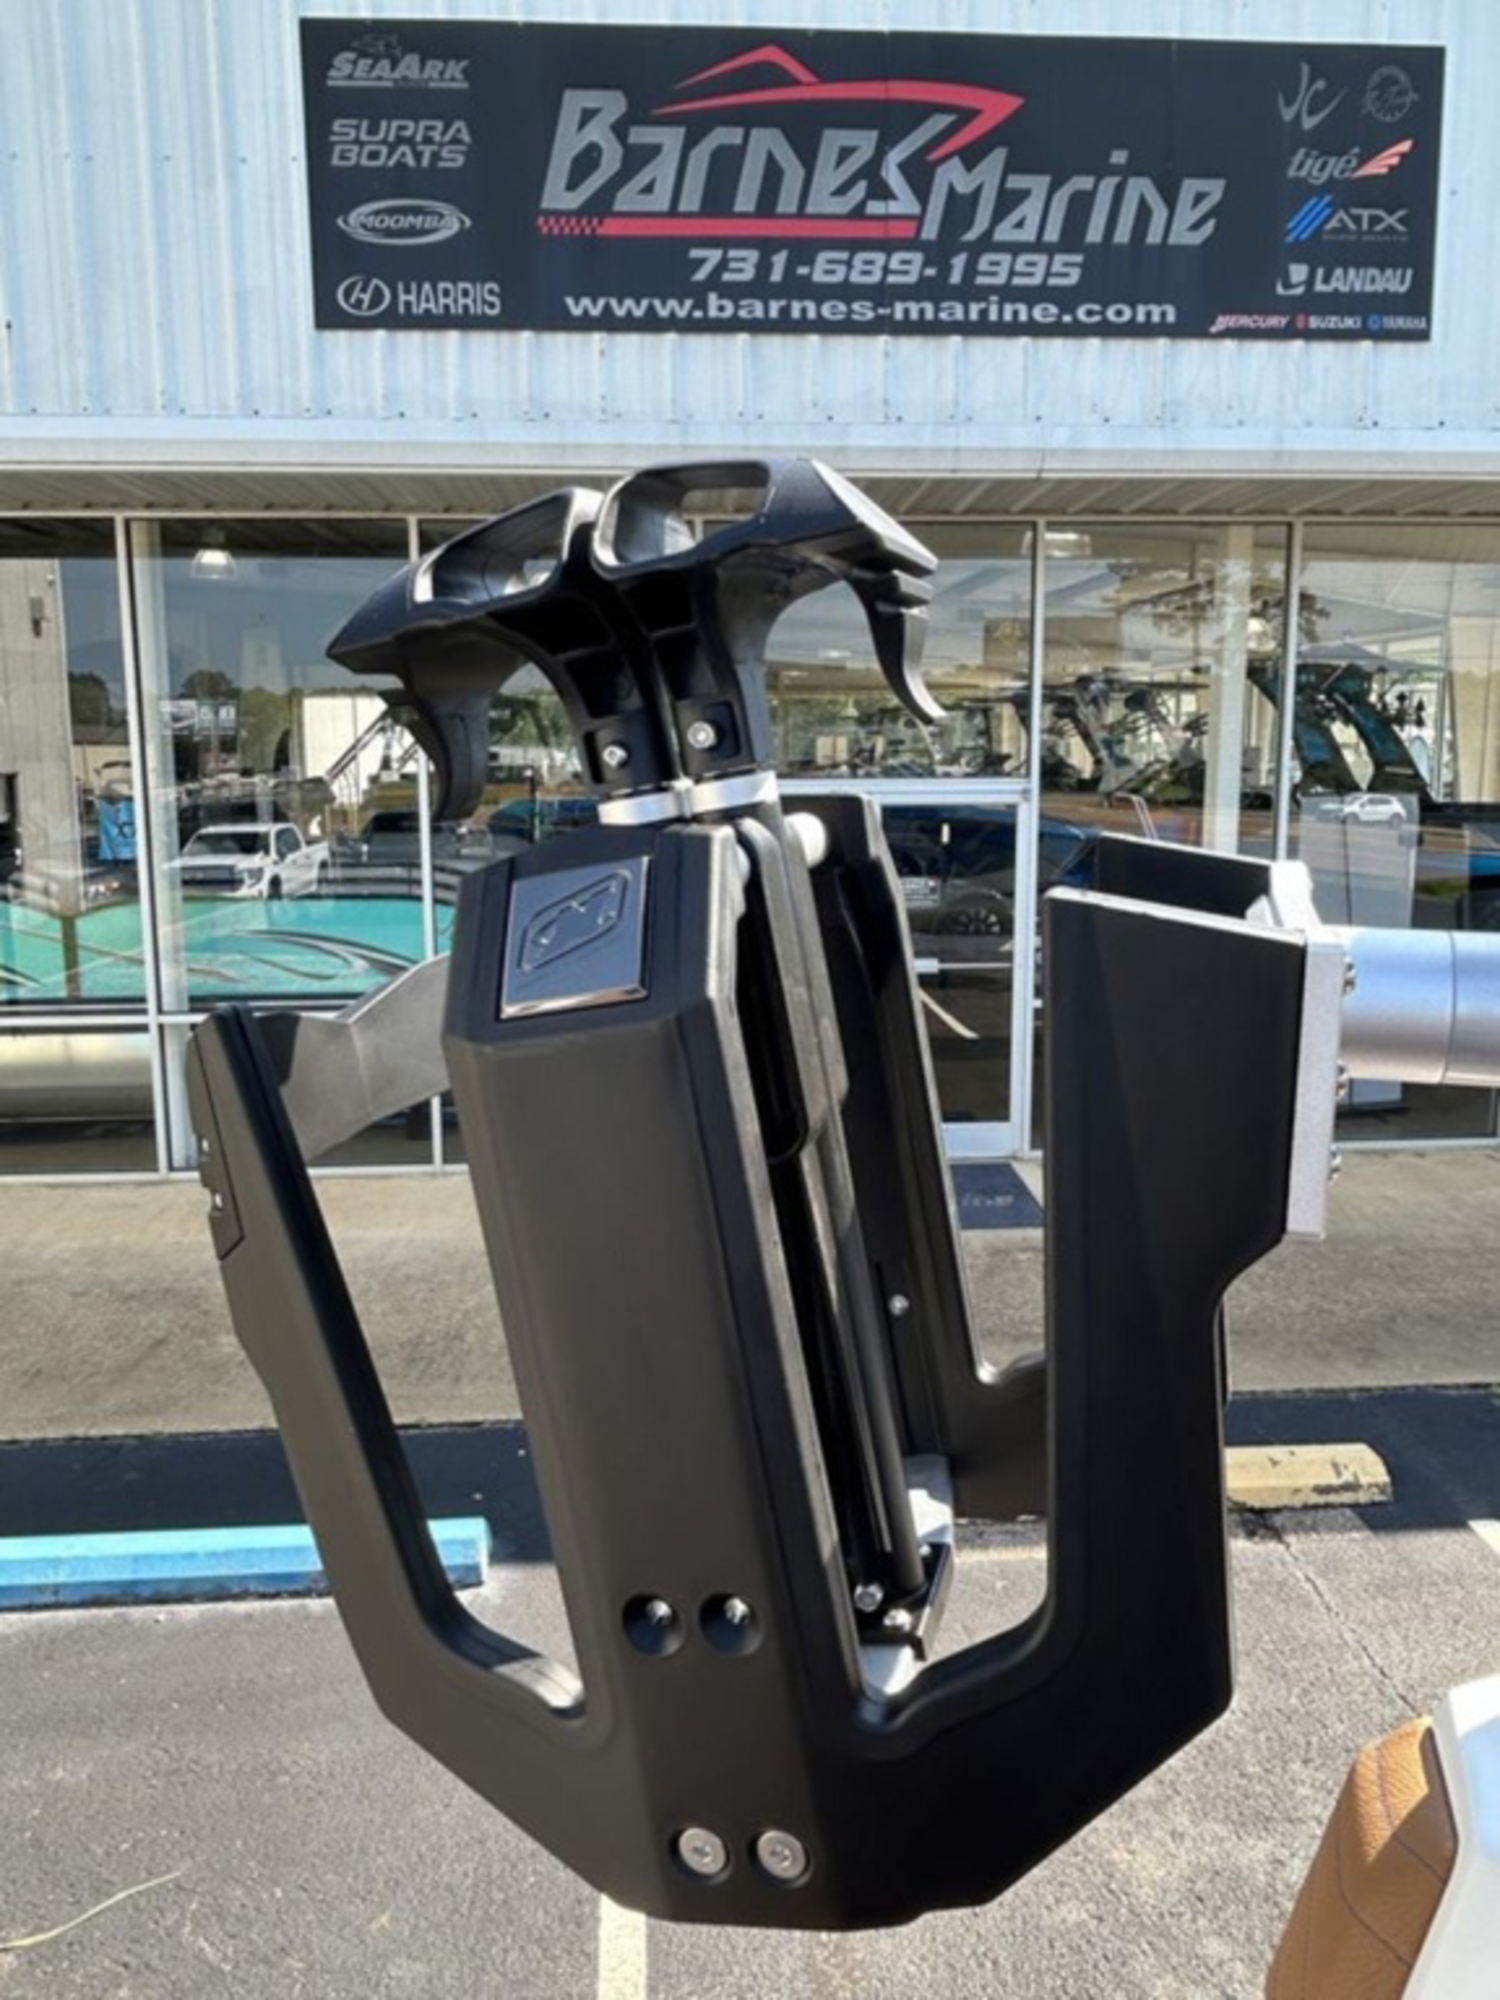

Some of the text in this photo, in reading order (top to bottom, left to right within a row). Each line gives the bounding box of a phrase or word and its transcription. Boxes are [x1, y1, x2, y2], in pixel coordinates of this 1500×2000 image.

[329, 119, 471, 143] SUPRA
[330, 144, 467, 168] BOATS
[919, 146, 1227, 246] Marine
[352, 214, 456, 230] MOOMBA
[1323, 208, 1409, 232] ATX
[688, 248, 1084, 286] 731-689-1995
[1313, 267, 1414, 293] LANDAU
[397, 281, 501, 316] HARRIS
[564, 291, 1177, 324] www.barnes-marine.com
[1209, 314, 1290, 334] MERCURY
[1308, 315, 1362, 330] SUZUKI
